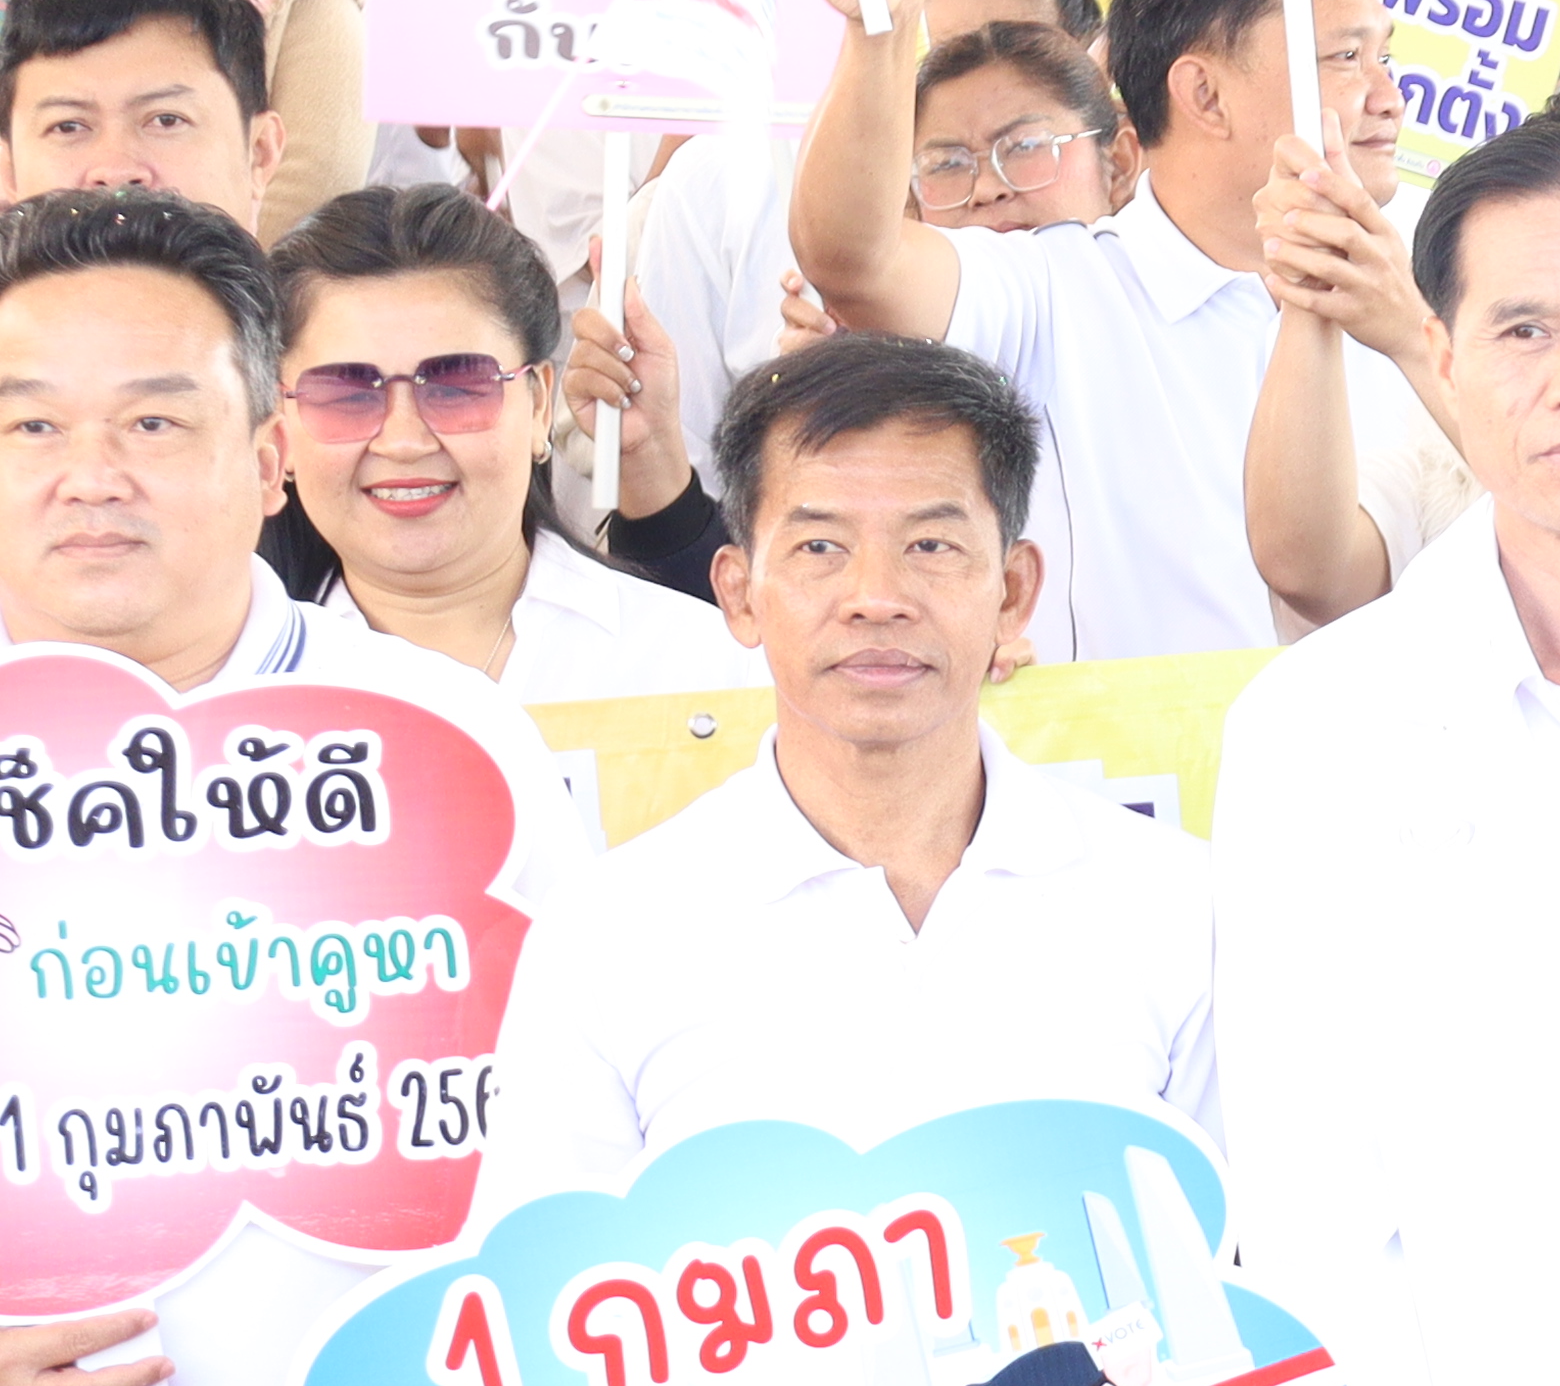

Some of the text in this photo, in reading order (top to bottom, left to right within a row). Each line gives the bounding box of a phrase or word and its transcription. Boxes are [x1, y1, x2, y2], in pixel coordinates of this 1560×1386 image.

[29, 910, 459, 1014] ก่อนเข้าคูหา
[0, 1094, 27, 1173] 1
[57, 1053, 371, 1201] กุมภาพันธ์
[1104, 1319, 1145, 1344] VOTE
